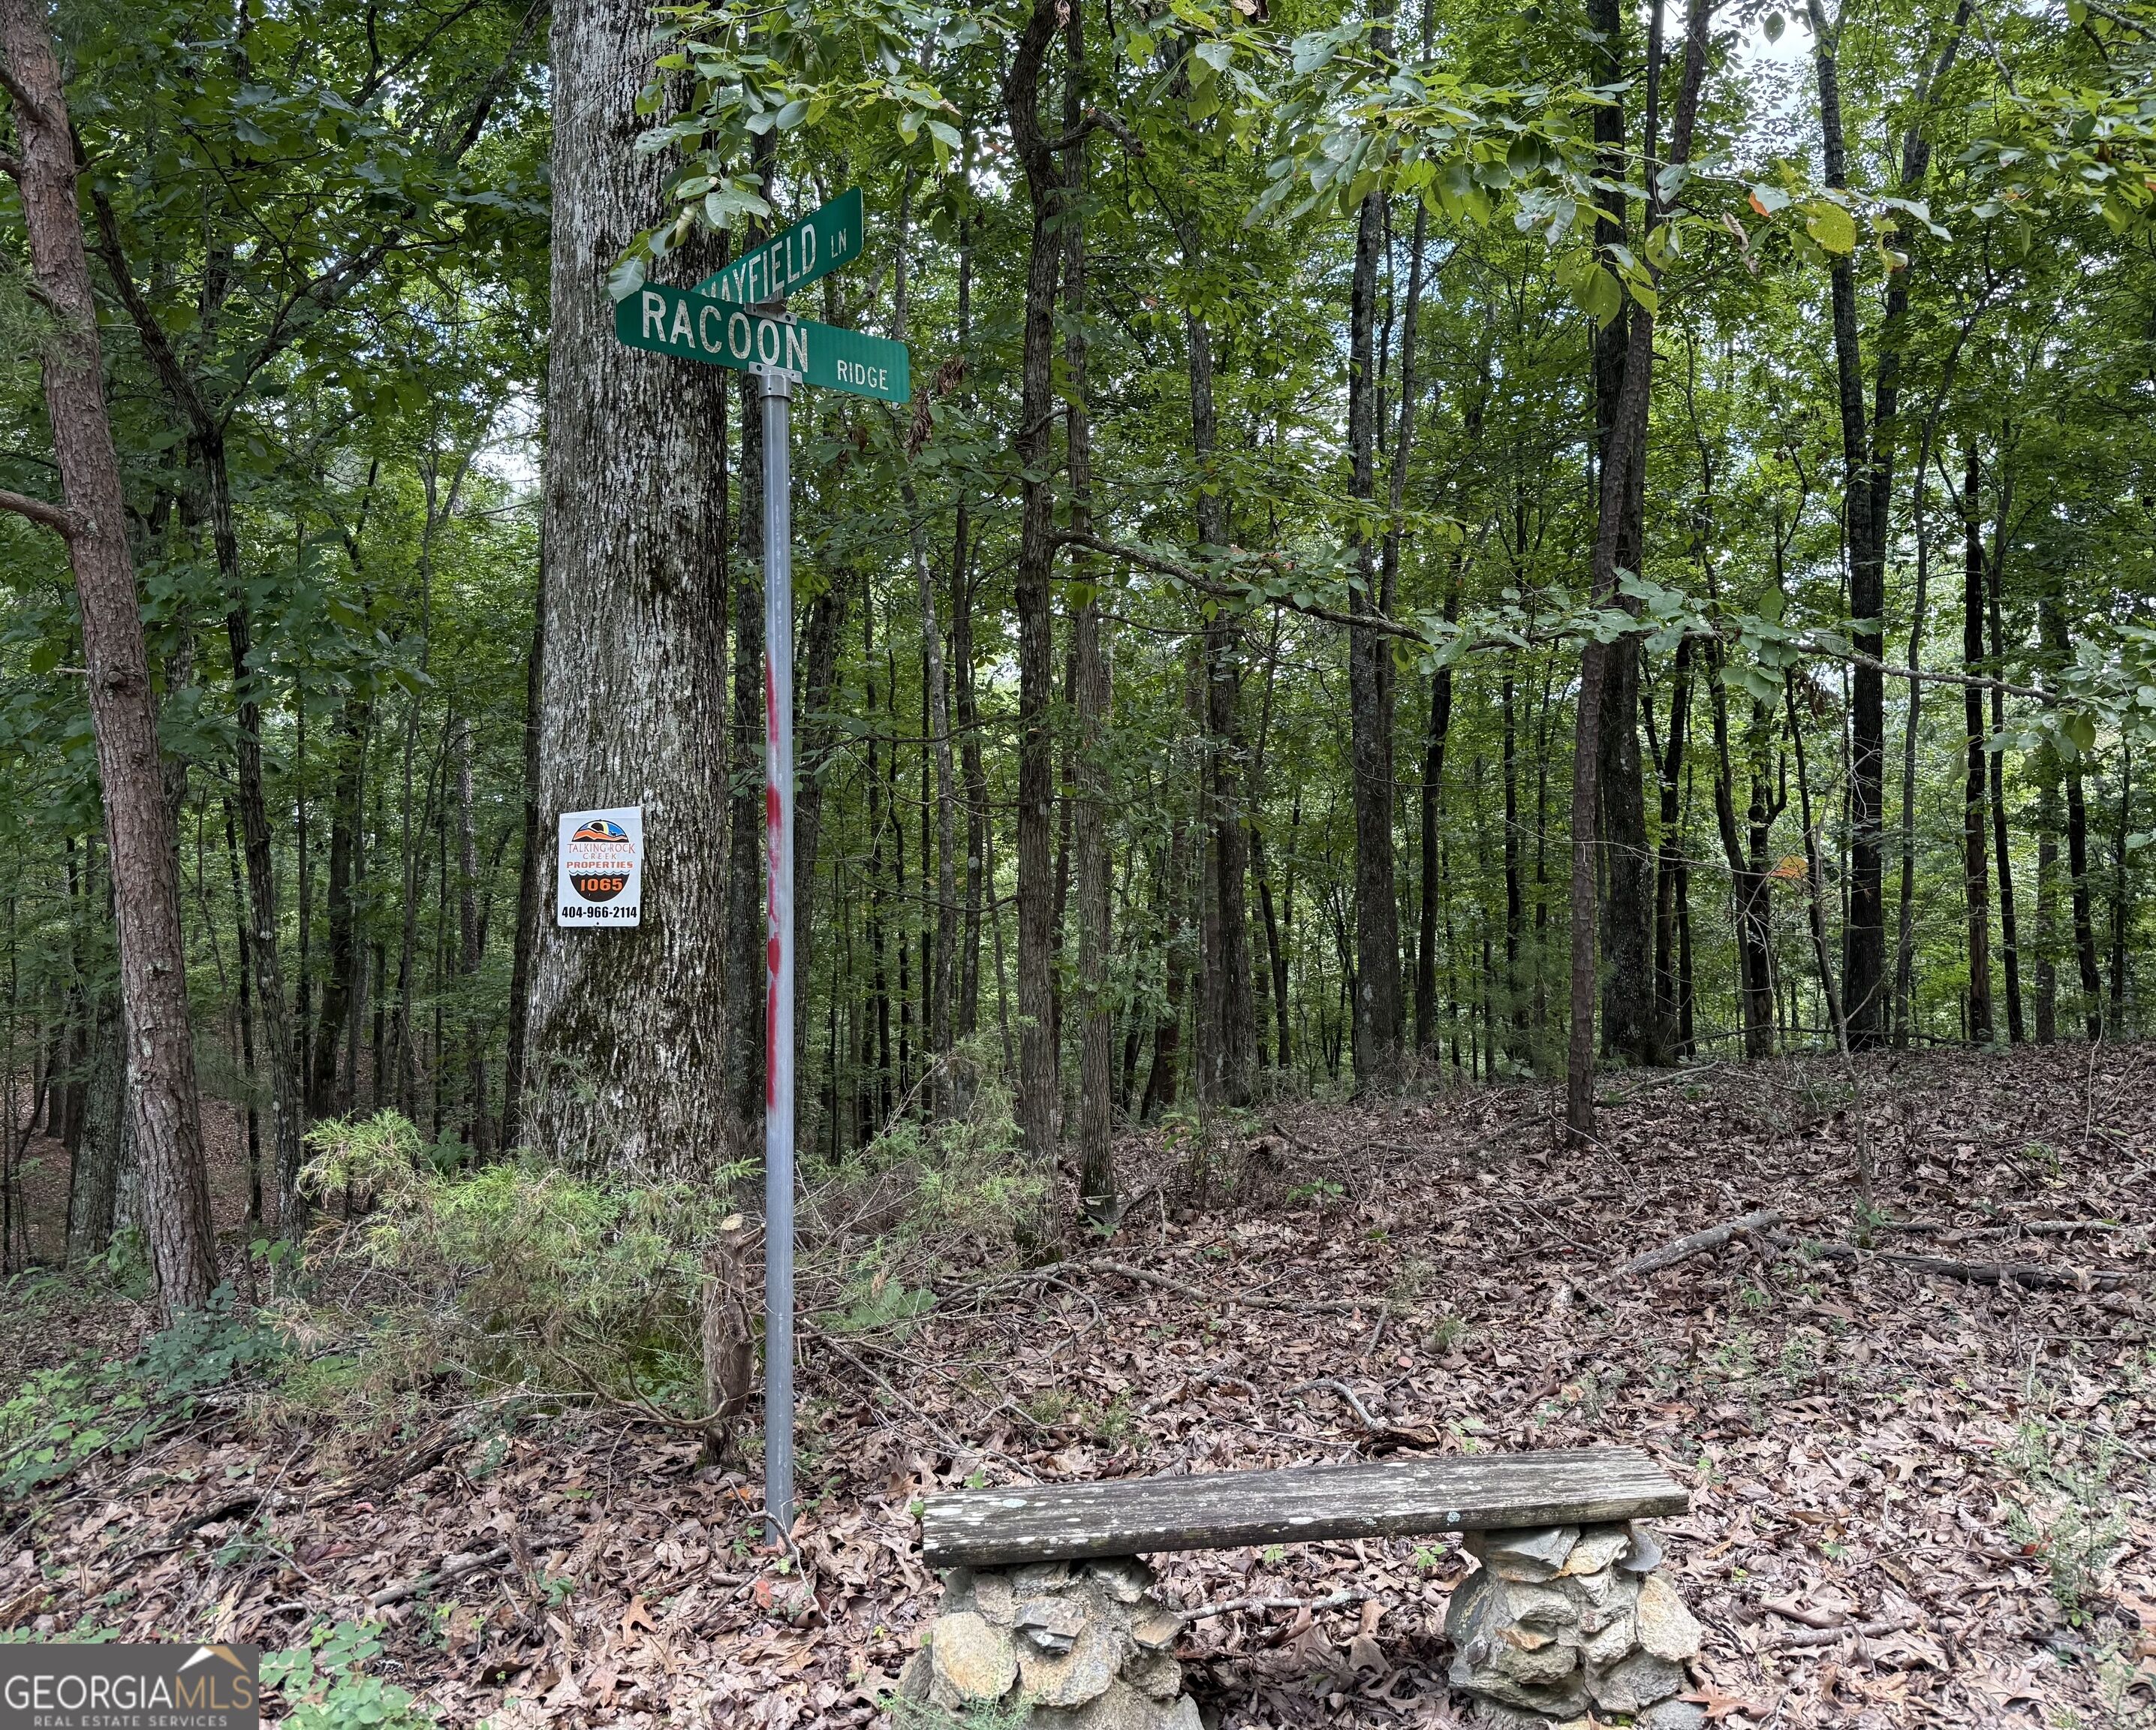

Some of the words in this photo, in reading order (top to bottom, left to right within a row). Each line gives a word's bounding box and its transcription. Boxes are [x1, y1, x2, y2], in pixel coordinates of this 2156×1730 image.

[830, 228, 847, 258] LN
[642, 291, 808, 373] RACOON
[837, 360, 889, 391] RIDGE
[567, 842, 606, 853] TALKING
[610, 842, 635, 853] ROCK
[580, 878, 623, 892] 1065
[562, 906, 637, 918] 404-966-2114
